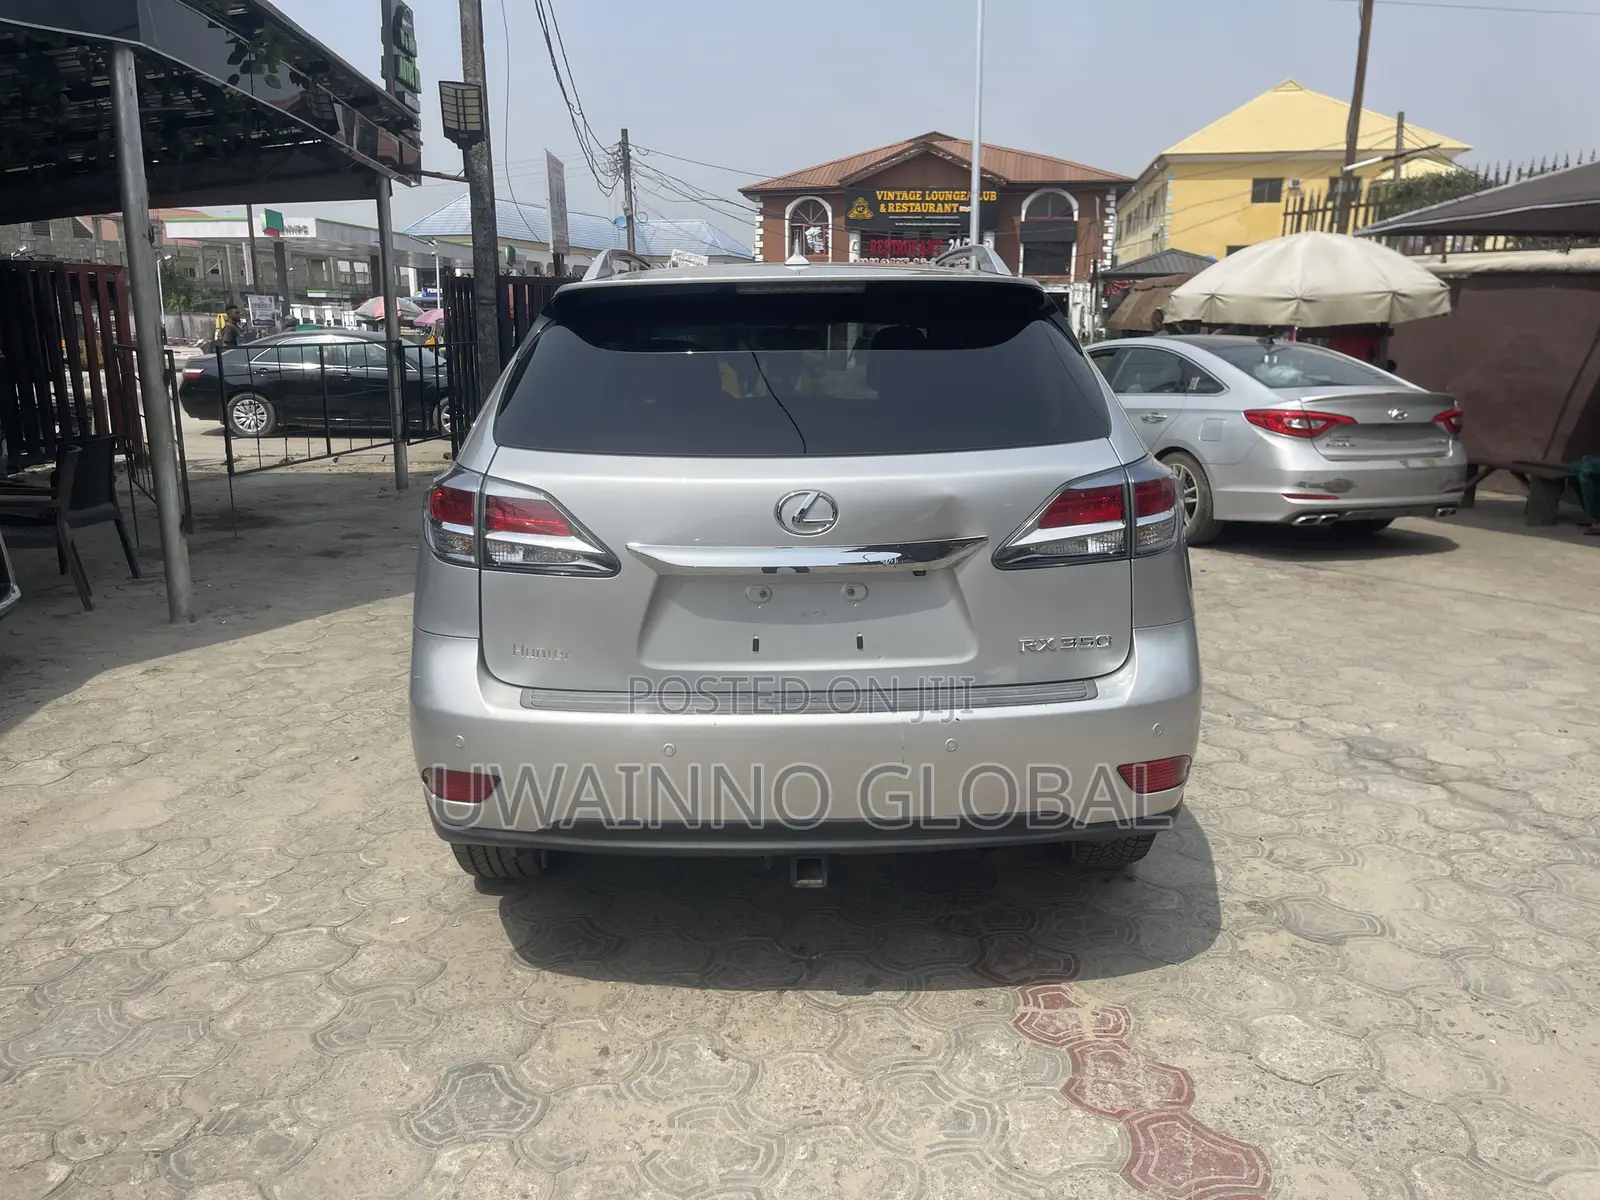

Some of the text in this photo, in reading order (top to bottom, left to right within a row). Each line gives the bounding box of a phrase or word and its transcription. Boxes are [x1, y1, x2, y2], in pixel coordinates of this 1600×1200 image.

[876, 190, 922, 201] VINTAGE
[879, 203, 887, 213] &
[888, 202, 959, 213] RESTAURANT
[870, 239, 944, 256] RESTAURANT
[511, 643, 571, 661] Hunter
[1018, 634, 1113, 653] RX 350
